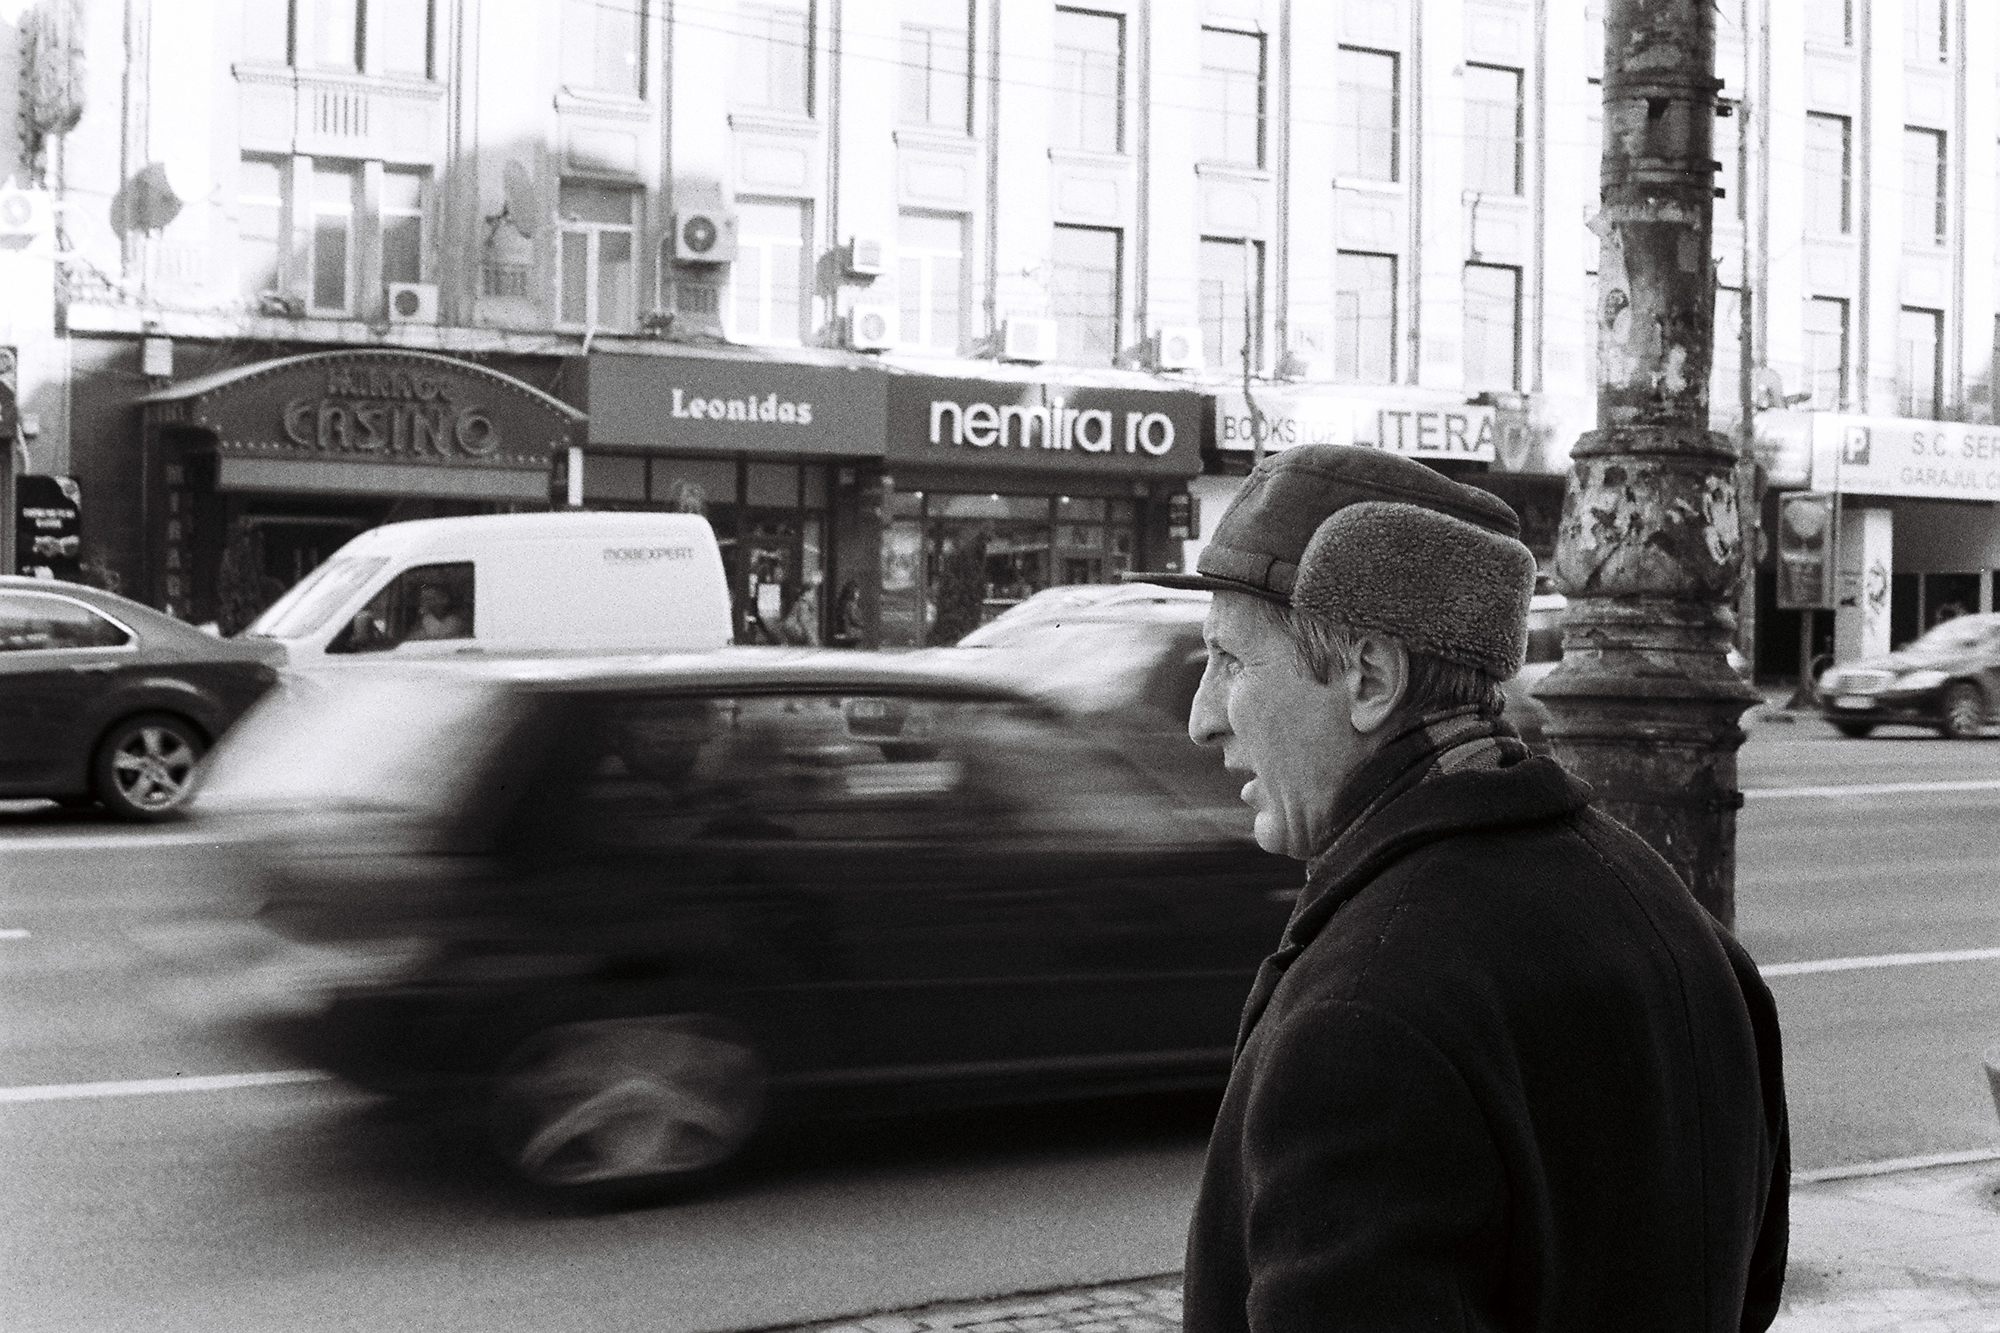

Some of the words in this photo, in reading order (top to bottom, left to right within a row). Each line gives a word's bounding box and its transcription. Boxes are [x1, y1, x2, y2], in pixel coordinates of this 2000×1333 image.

[283, 399, 499, 456] CASINO
[671, 388, 812, 424] Leonidas
[929, 396, 1112, 452] nemira
[1125, 412, 1176, 455] ro
